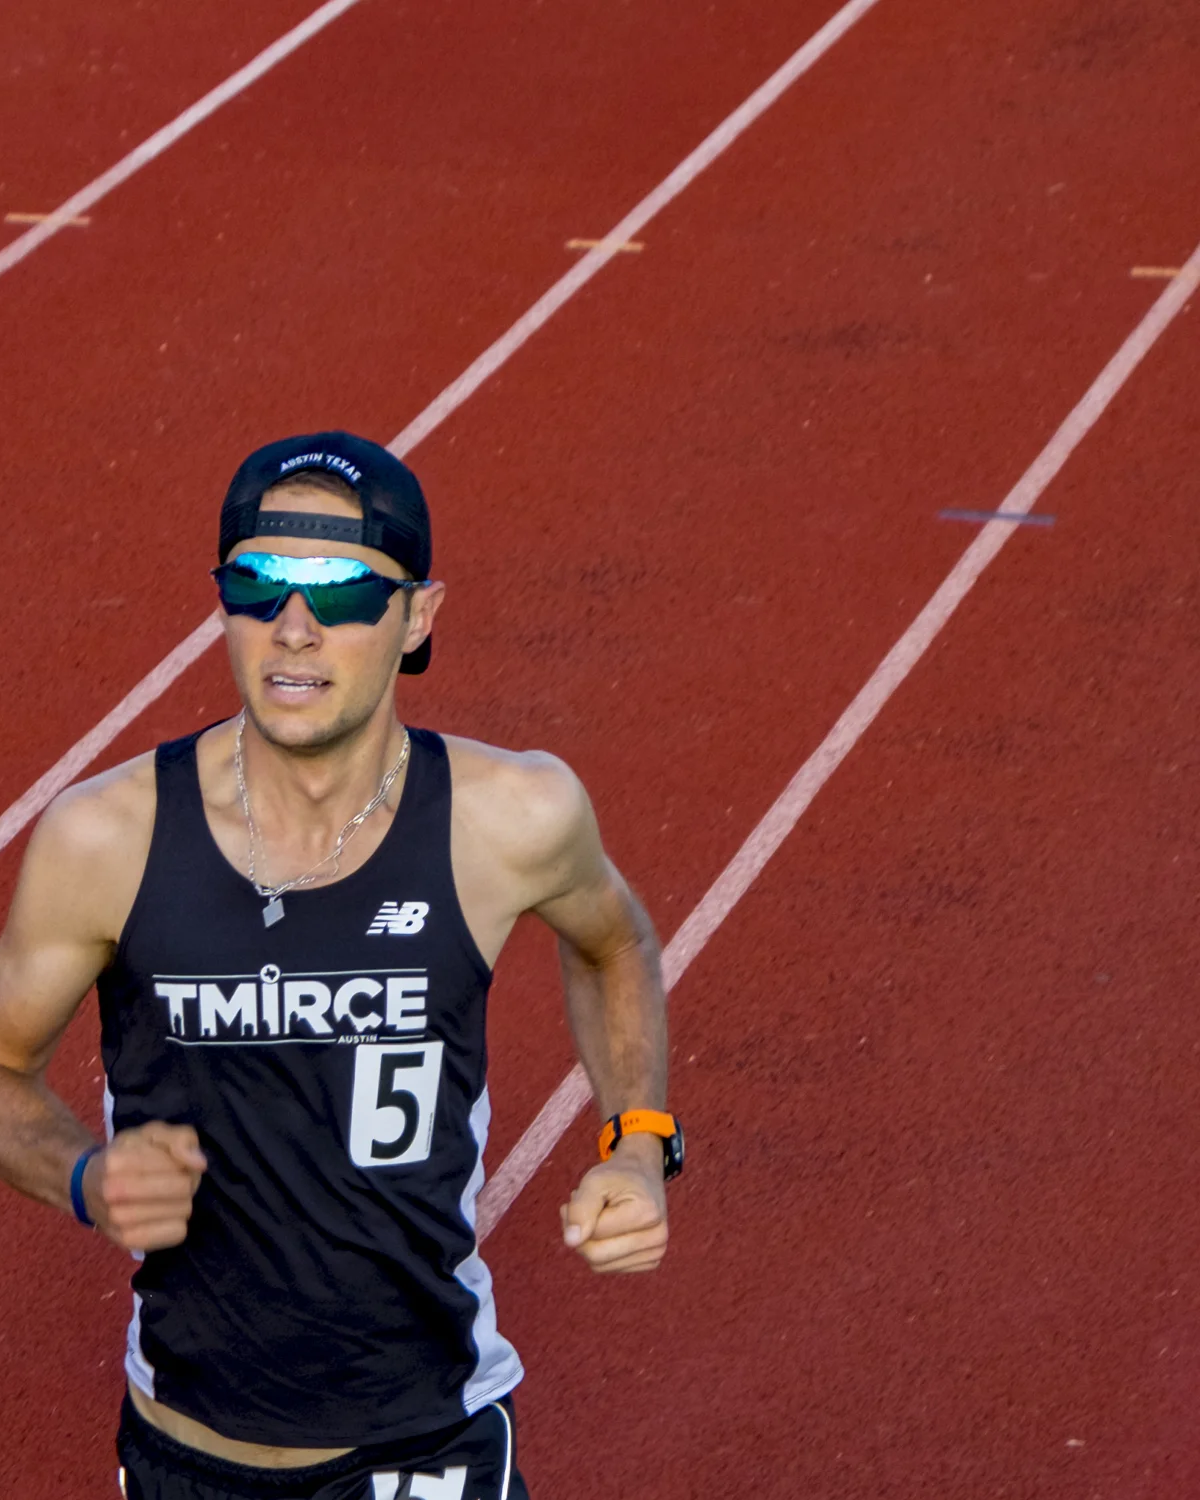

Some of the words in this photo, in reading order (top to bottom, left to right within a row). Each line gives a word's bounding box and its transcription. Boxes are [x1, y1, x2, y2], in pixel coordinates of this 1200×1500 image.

[281, 453, 323, 472] AUSTIN
[326, 455, 362, 482] TEXAS
[337, 1034, 377, 1044] AUSTIN
[370, 1051, 426, 1160] 5
